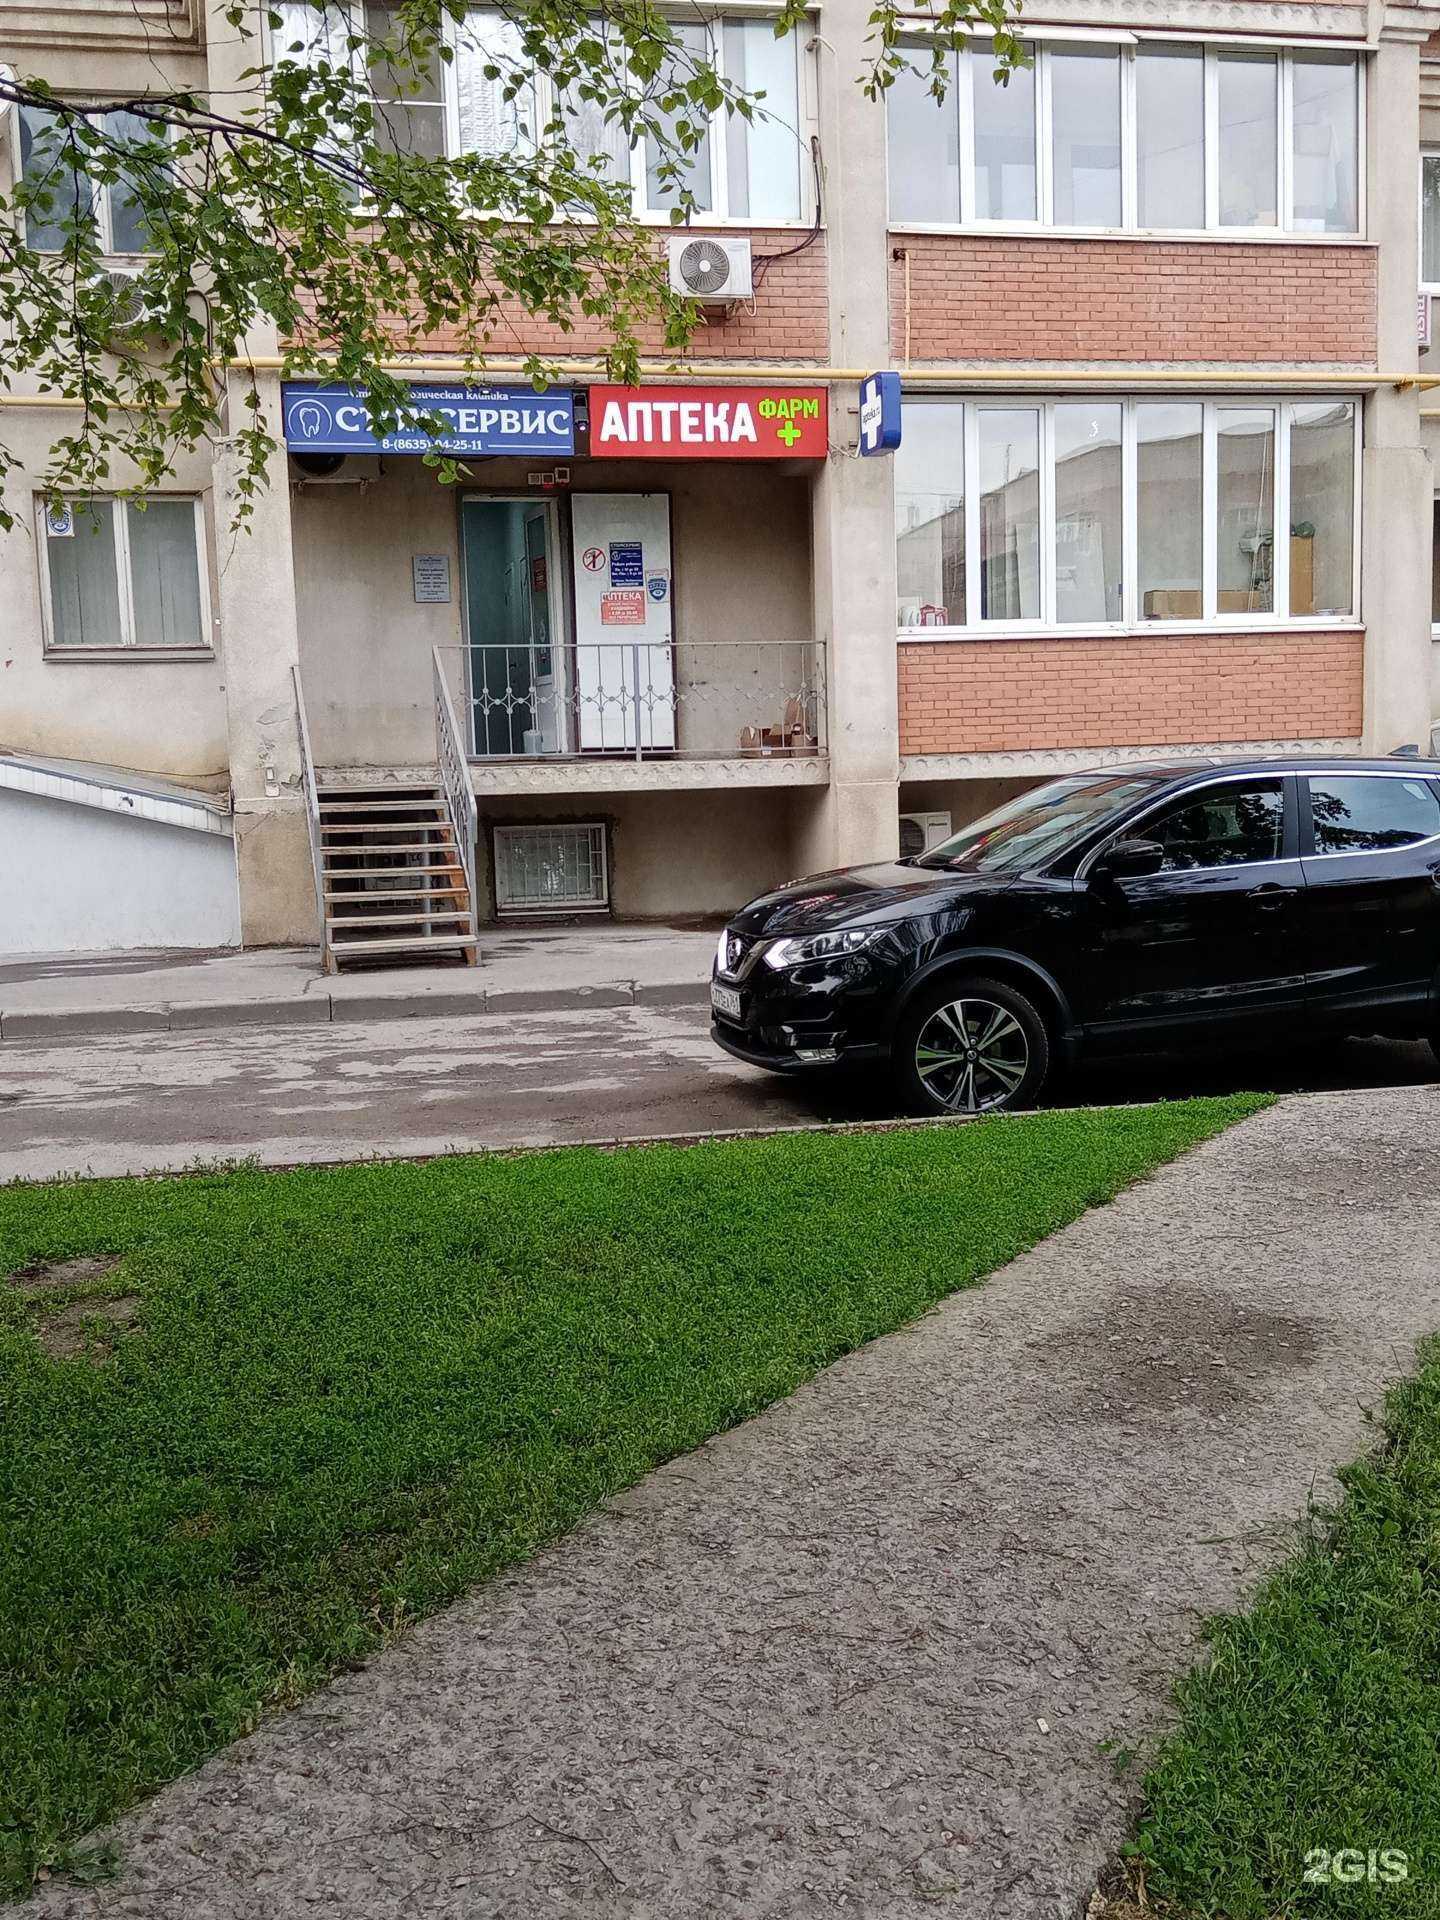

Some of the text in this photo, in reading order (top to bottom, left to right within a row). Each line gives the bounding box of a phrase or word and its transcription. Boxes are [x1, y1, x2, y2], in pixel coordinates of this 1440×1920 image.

[349, 389, 463, 400] Стогическая
[599, 398, 819, 443] АПТЕКА ФАРМ
